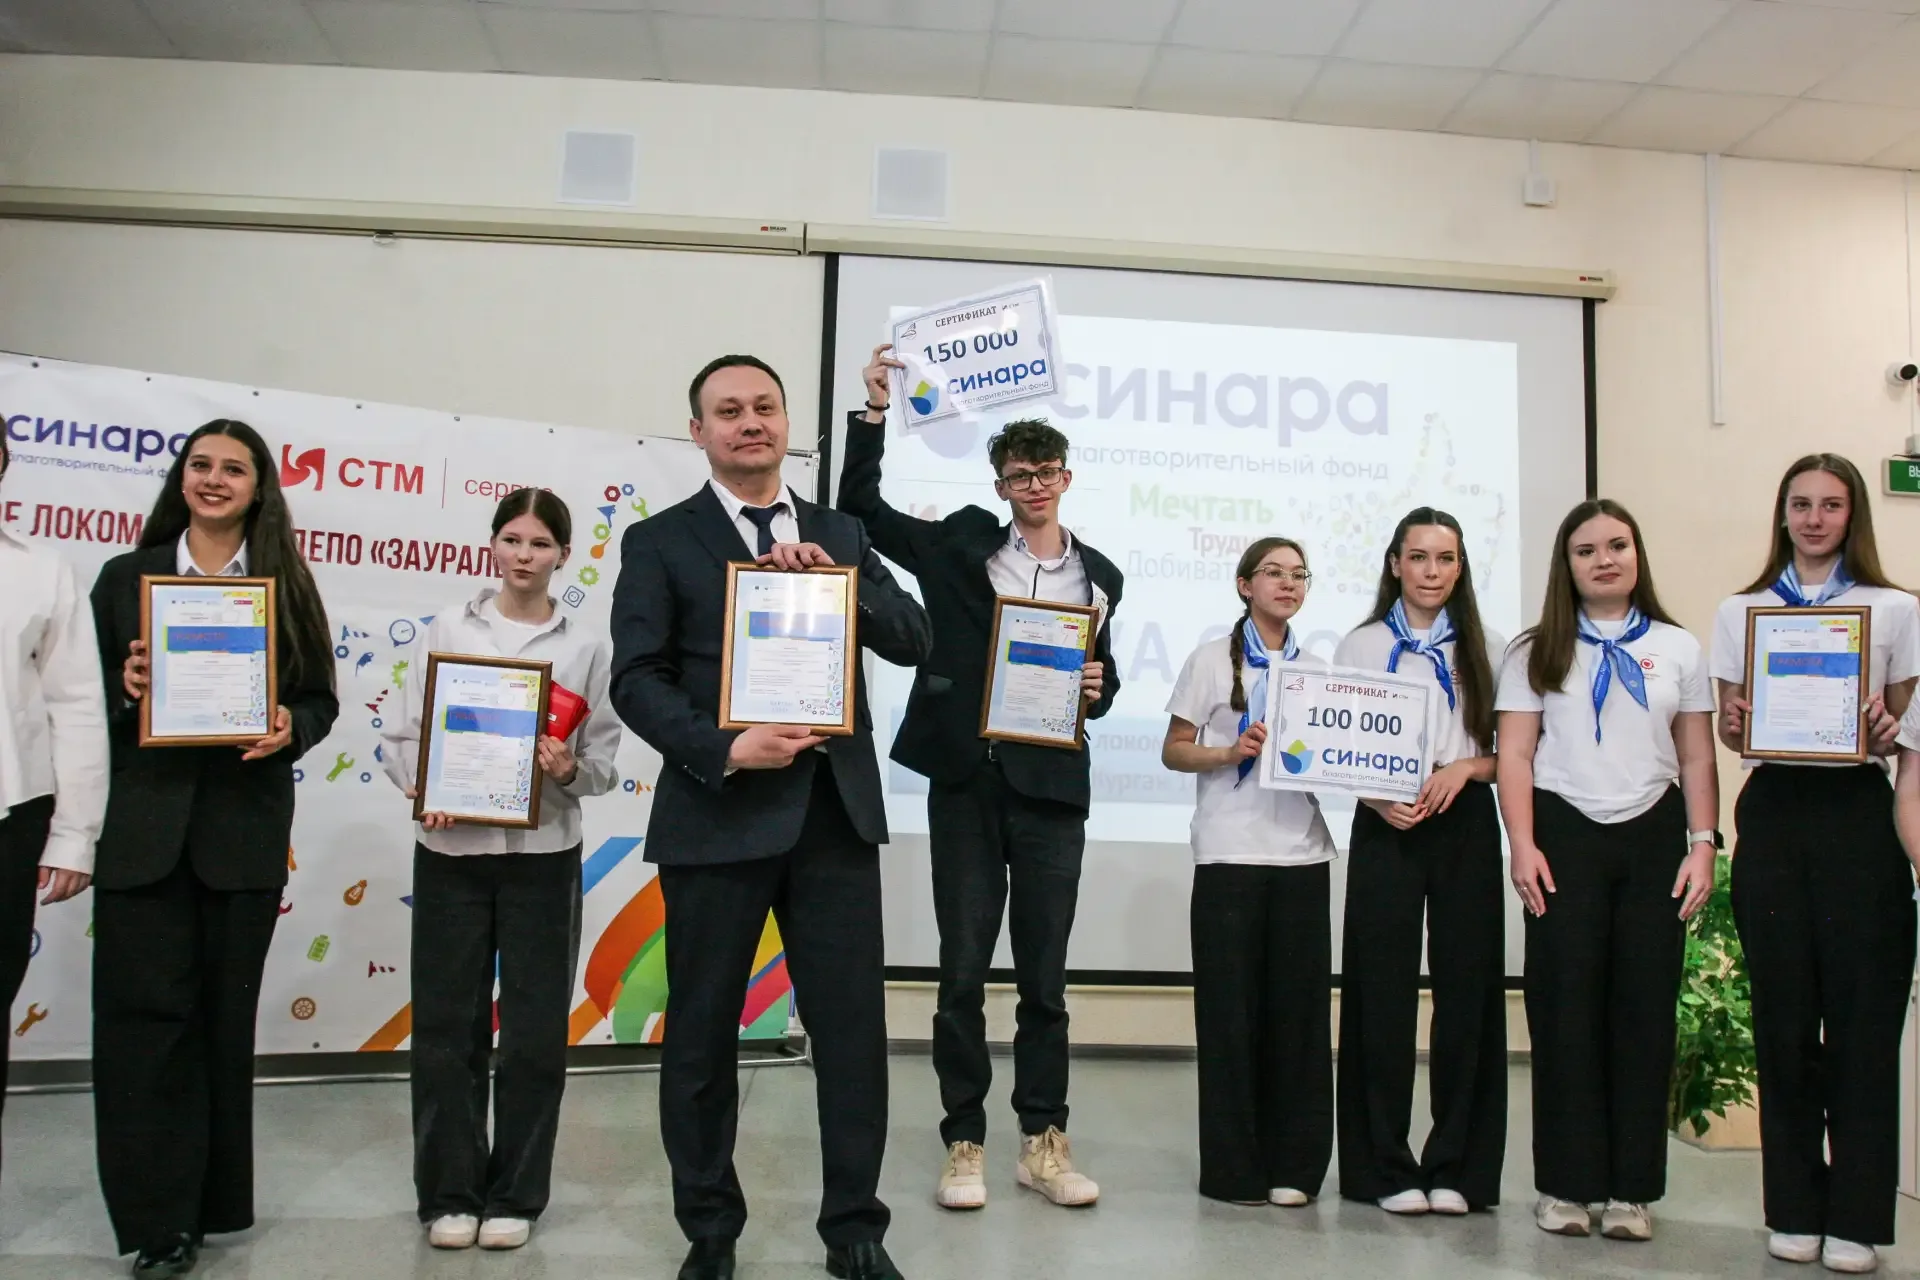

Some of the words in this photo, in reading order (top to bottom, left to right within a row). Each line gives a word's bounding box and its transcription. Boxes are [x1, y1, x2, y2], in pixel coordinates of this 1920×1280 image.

[935, 305, 998, 328] СЕРТИФИКАТ
[923, 338, 967, 365] 150
[973, 327, 1019, 355] 000
[946, 357, 1048, 395] синара
[1049, 362, 1389, 448] синара
[338, 457, 424, 495] СТМ
[465, 479, 552, 502] сер
[1068, 446, 1314, 476] лаготворительный
[1322, 458, 1388, 481] фонд
[1129, 482, 1275, 525] Мечтать
[29, 503, 144, 545] ЛОКОМ
[1125, 549, 1238, 582] Добиват
[1325, 683, 1388, 699] СЕРТИФИКАТ
[1307, 705, 1352, 730] 100
[1359, 711, 1402, 736] 000
[1321, 747, 1420, 776] синара
